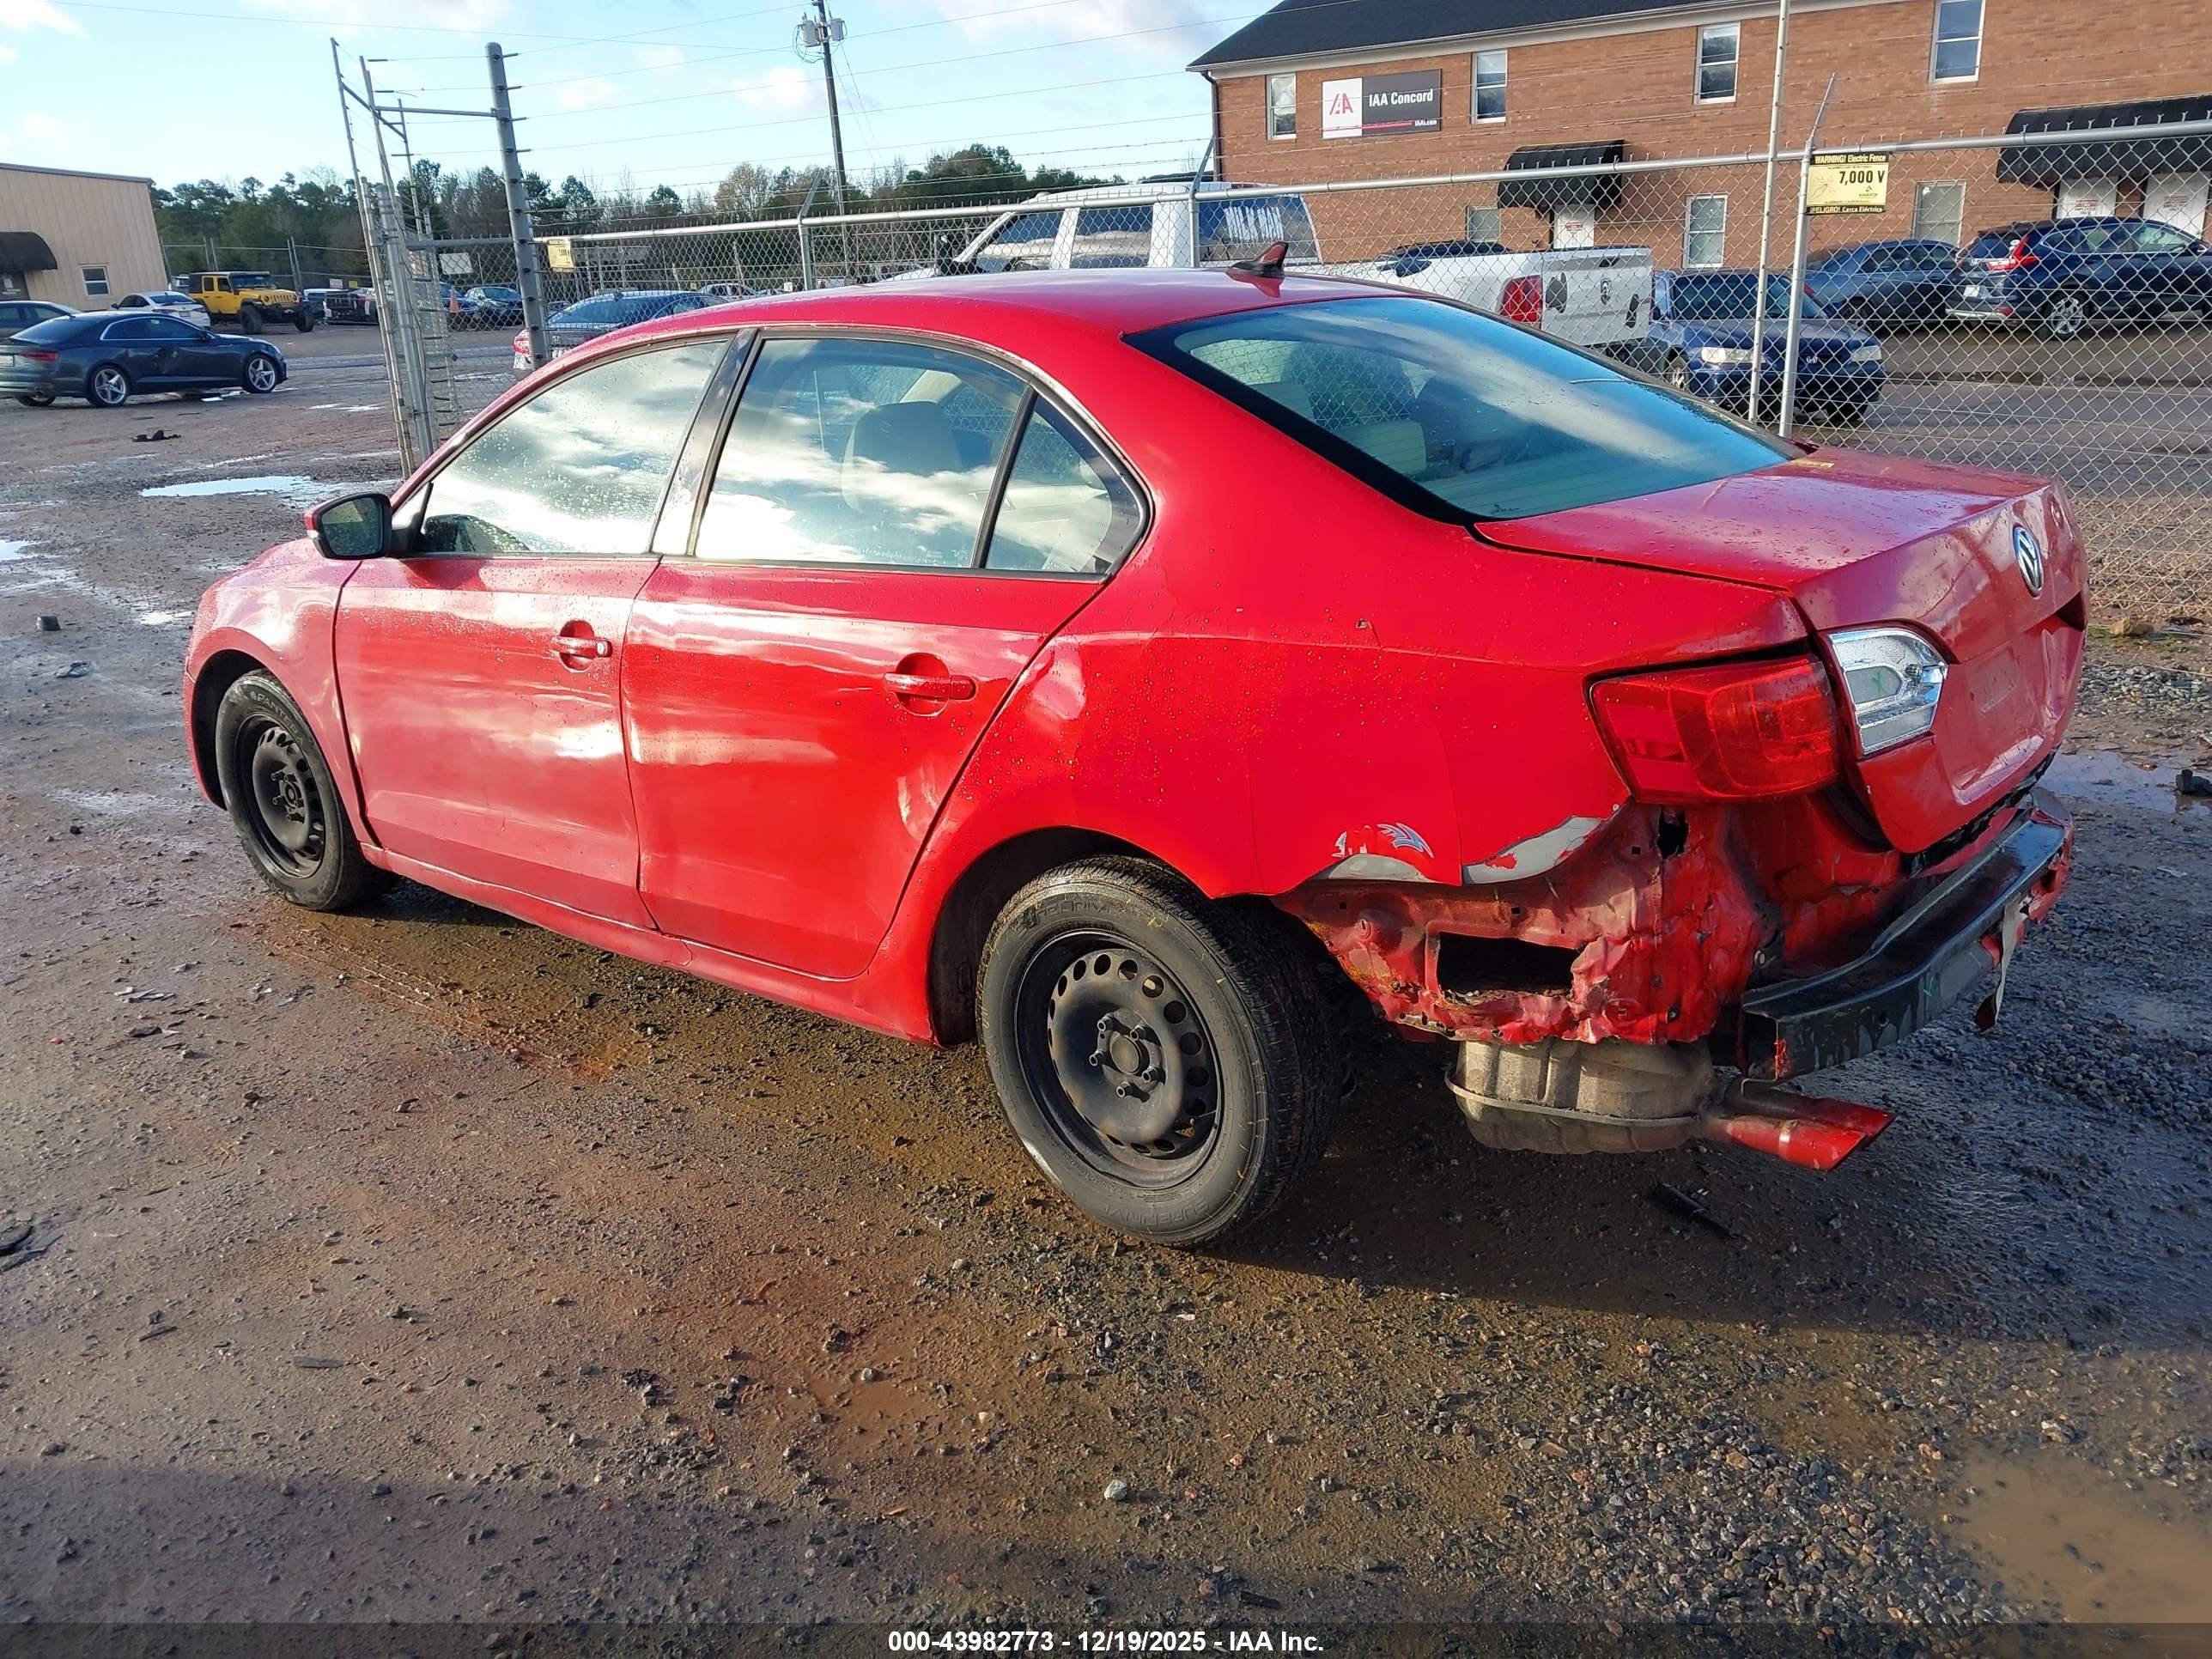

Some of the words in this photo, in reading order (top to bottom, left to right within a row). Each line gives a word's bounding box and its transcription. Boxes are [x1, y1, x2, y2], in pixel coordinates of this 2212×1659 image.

[1369, 94, 1389, 107] IAA
[1390, 88, 1434, 105] Concord
[1814, 155, 1846, 164] WARNING!
[1869, 154, 1887, 162] Fence
[1838, 170, 1874, 186] 7,000
[1877, 170, 1885, 183] V
